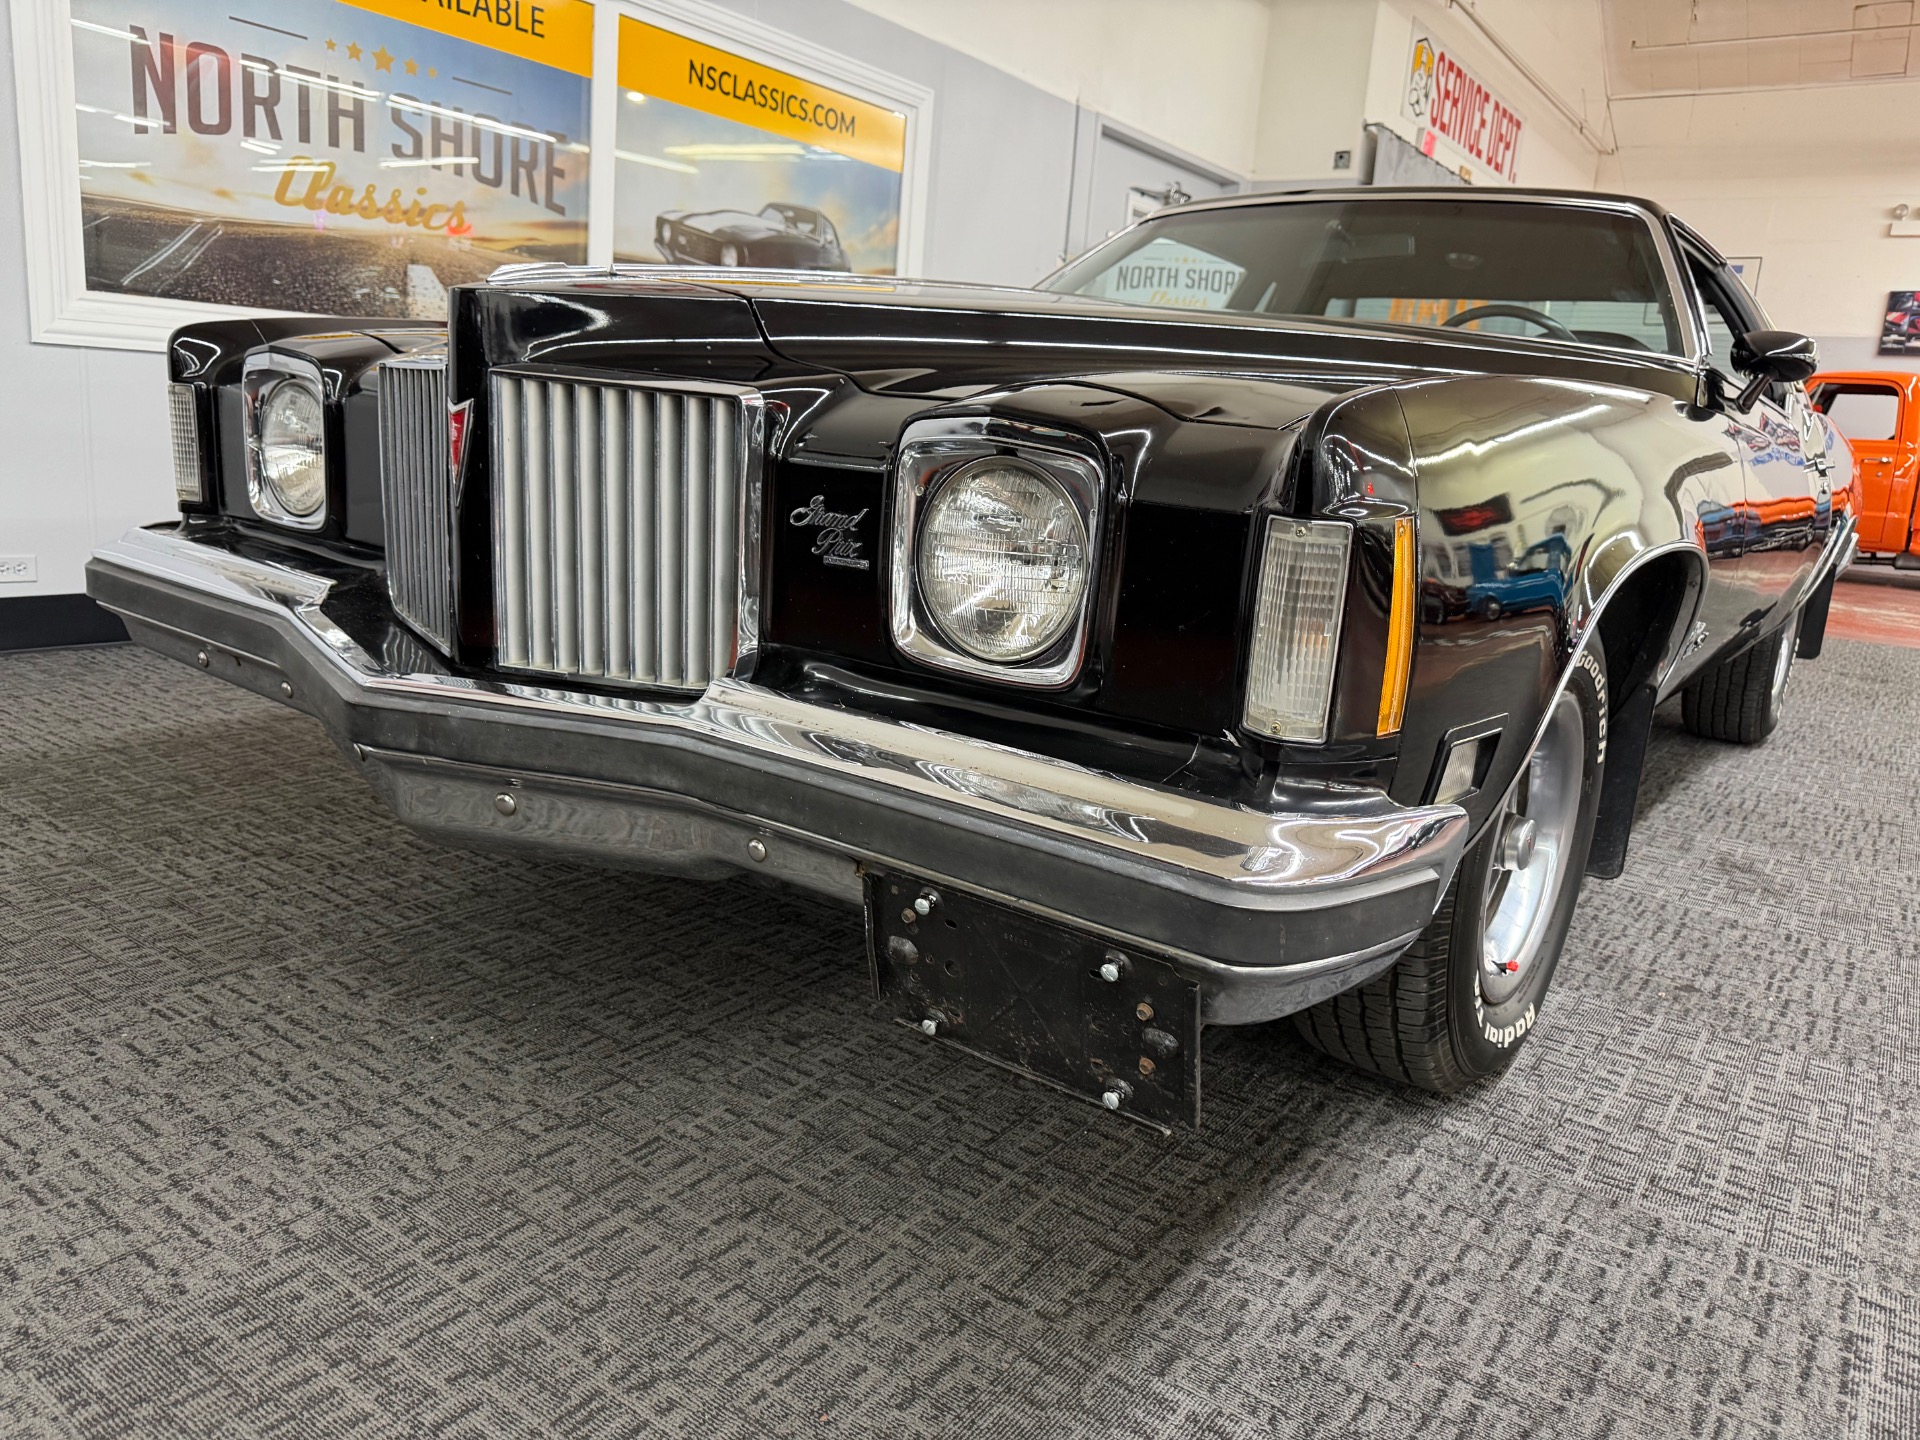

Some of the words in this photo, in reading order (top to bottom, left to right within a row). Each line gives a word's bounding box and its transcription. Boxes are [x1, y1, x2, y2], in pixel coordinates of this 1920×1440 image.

[129, 25, 365, 153] NORTH
[391, 93, 567, 216] SHORE
[688, 58, 856, 138] NSCLASSICS.COM
[1430, 51, 1490, 160] SERVICE
[1486, 99, 1521, 184] DEPT.
[274, 156, 471, 234] Classics
[1115, 265, 1178, 291] NORTH
[1185, 268, 1240, 295] SHOR
[1484, 1002, 1536, 1048] Radial
